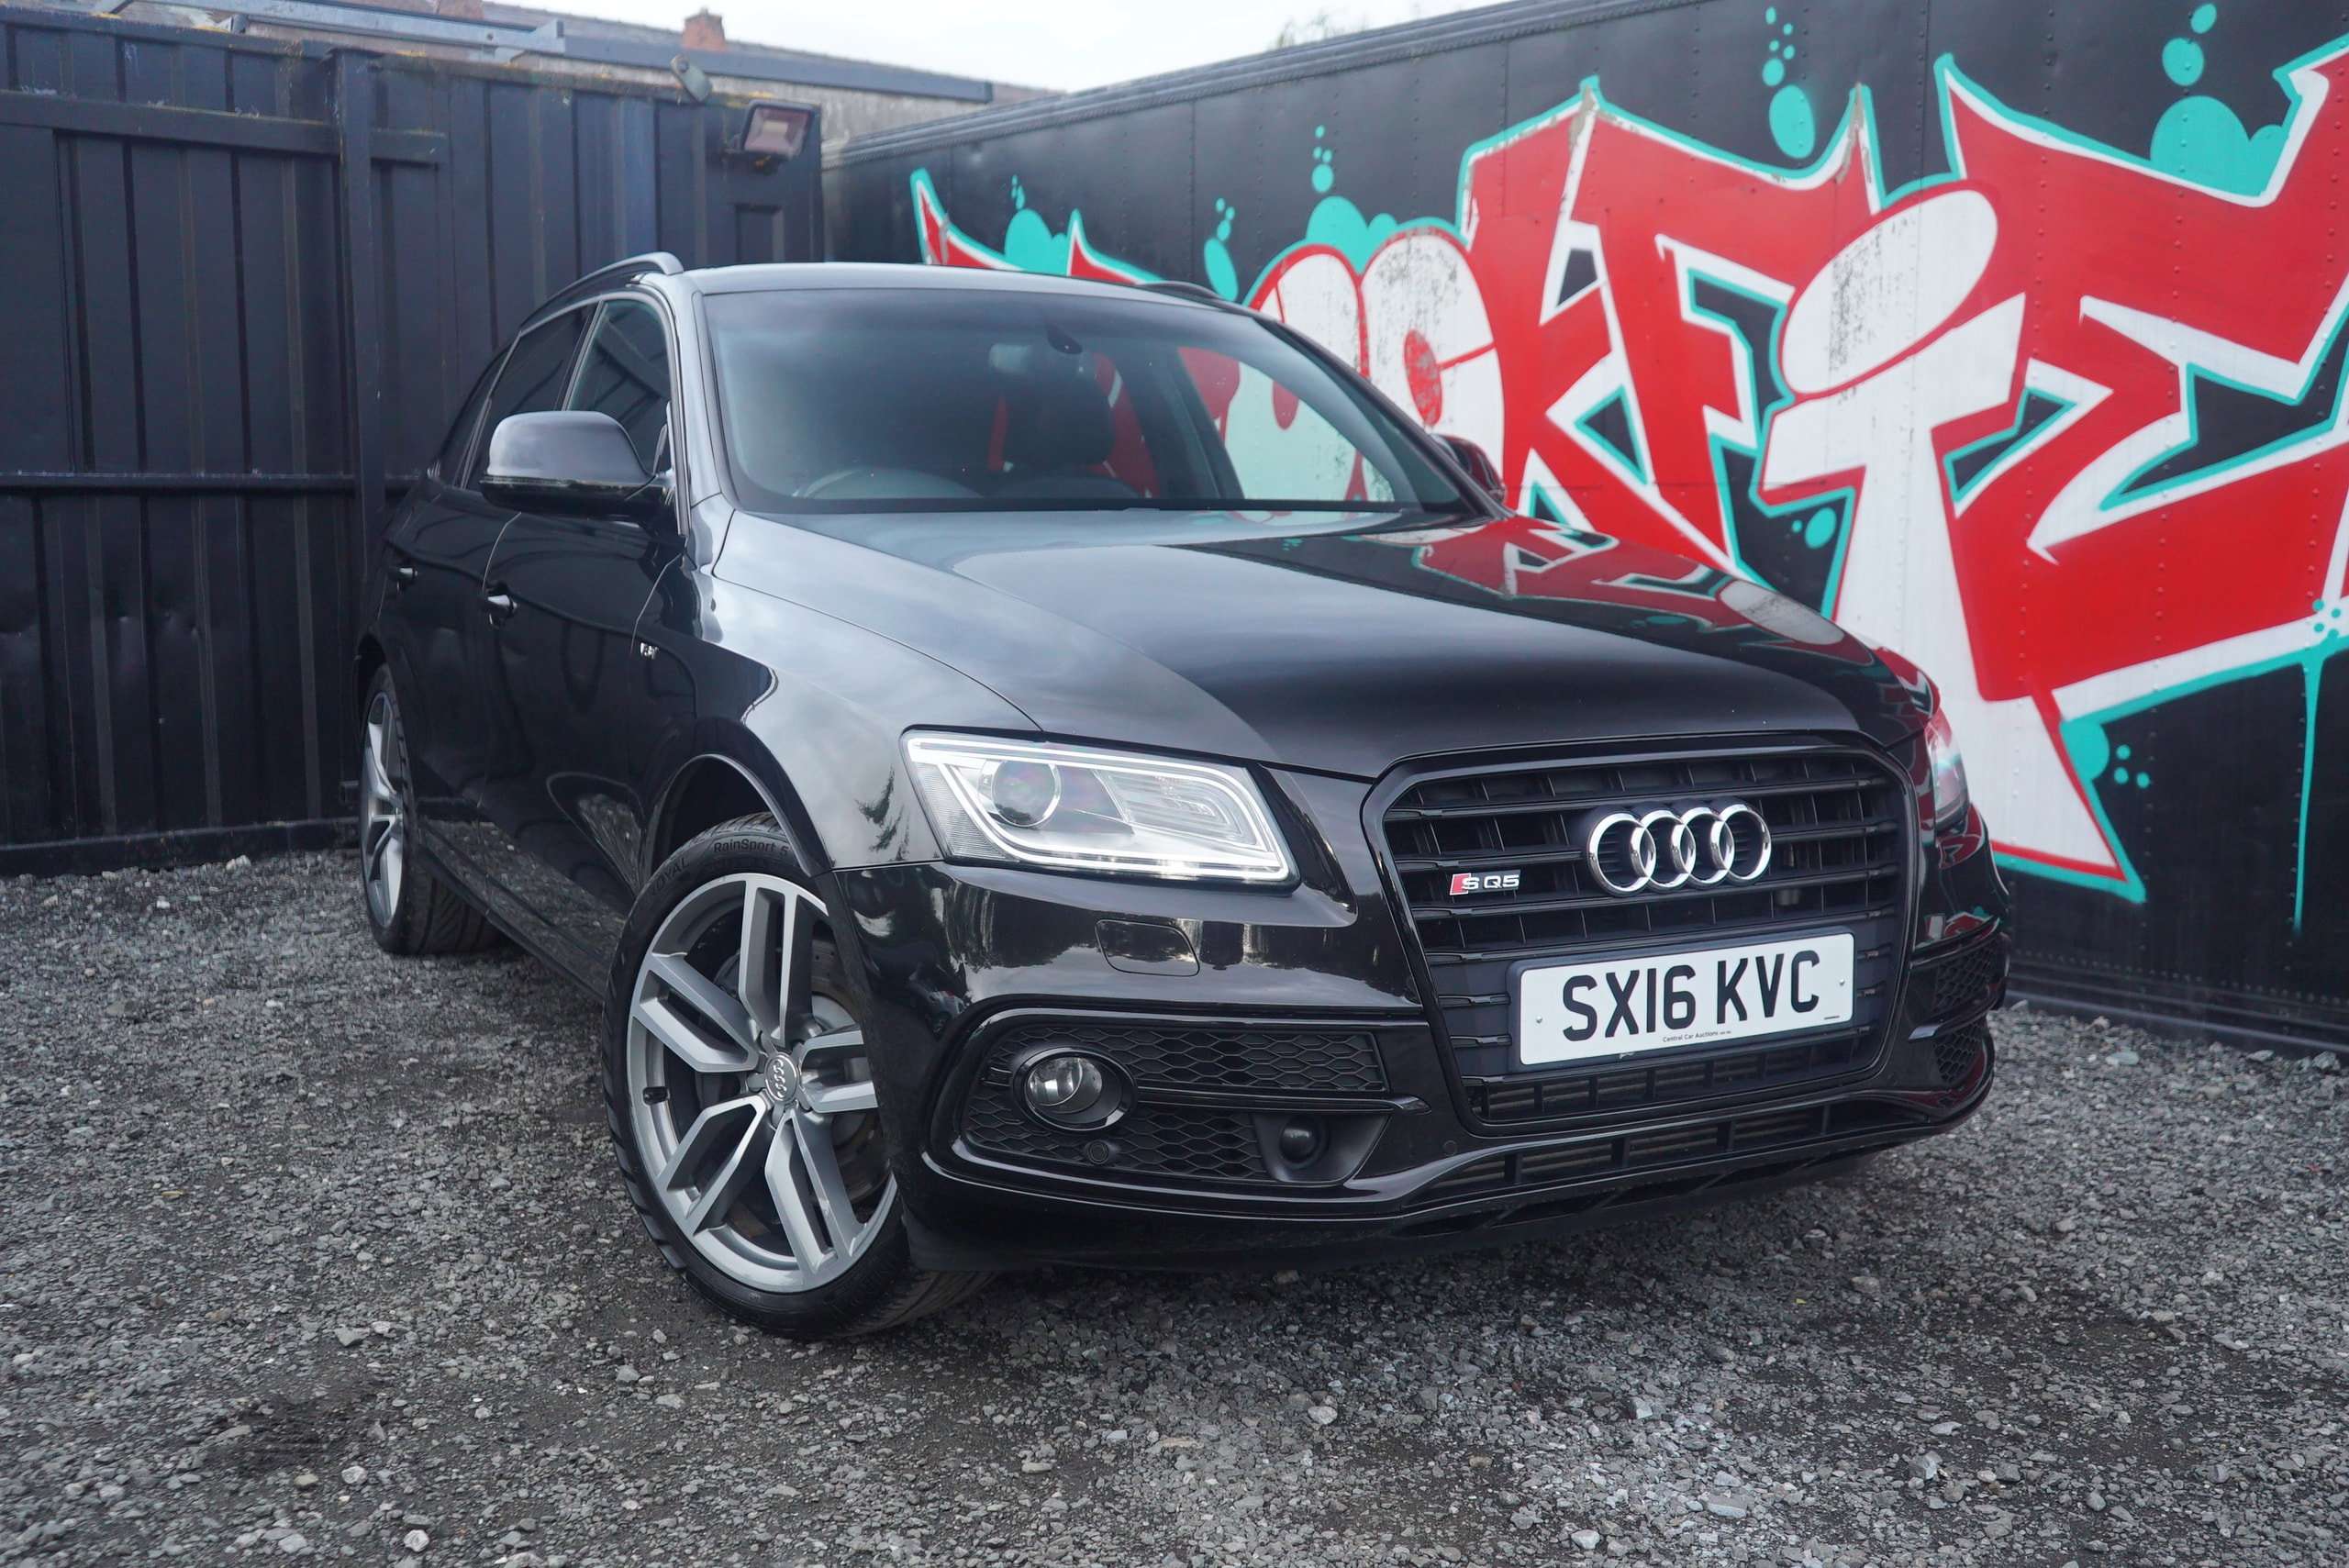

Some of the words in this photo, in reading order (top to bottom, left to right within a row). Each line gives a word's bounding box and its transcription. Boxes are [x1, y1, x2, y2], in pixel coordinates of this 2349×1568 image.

[713, 838, 776, 853] RainSport
[779, 845, 789, 856] 5
[1460, 873, 1520, 890] SQ5
[1563, 964, 1697, 1041] SX16
[1716, 950, 1821, 1024] KVC
[1663, 1034, 1683, 1042] Central
[1695, 1030, 1719, 1039] Auctions
